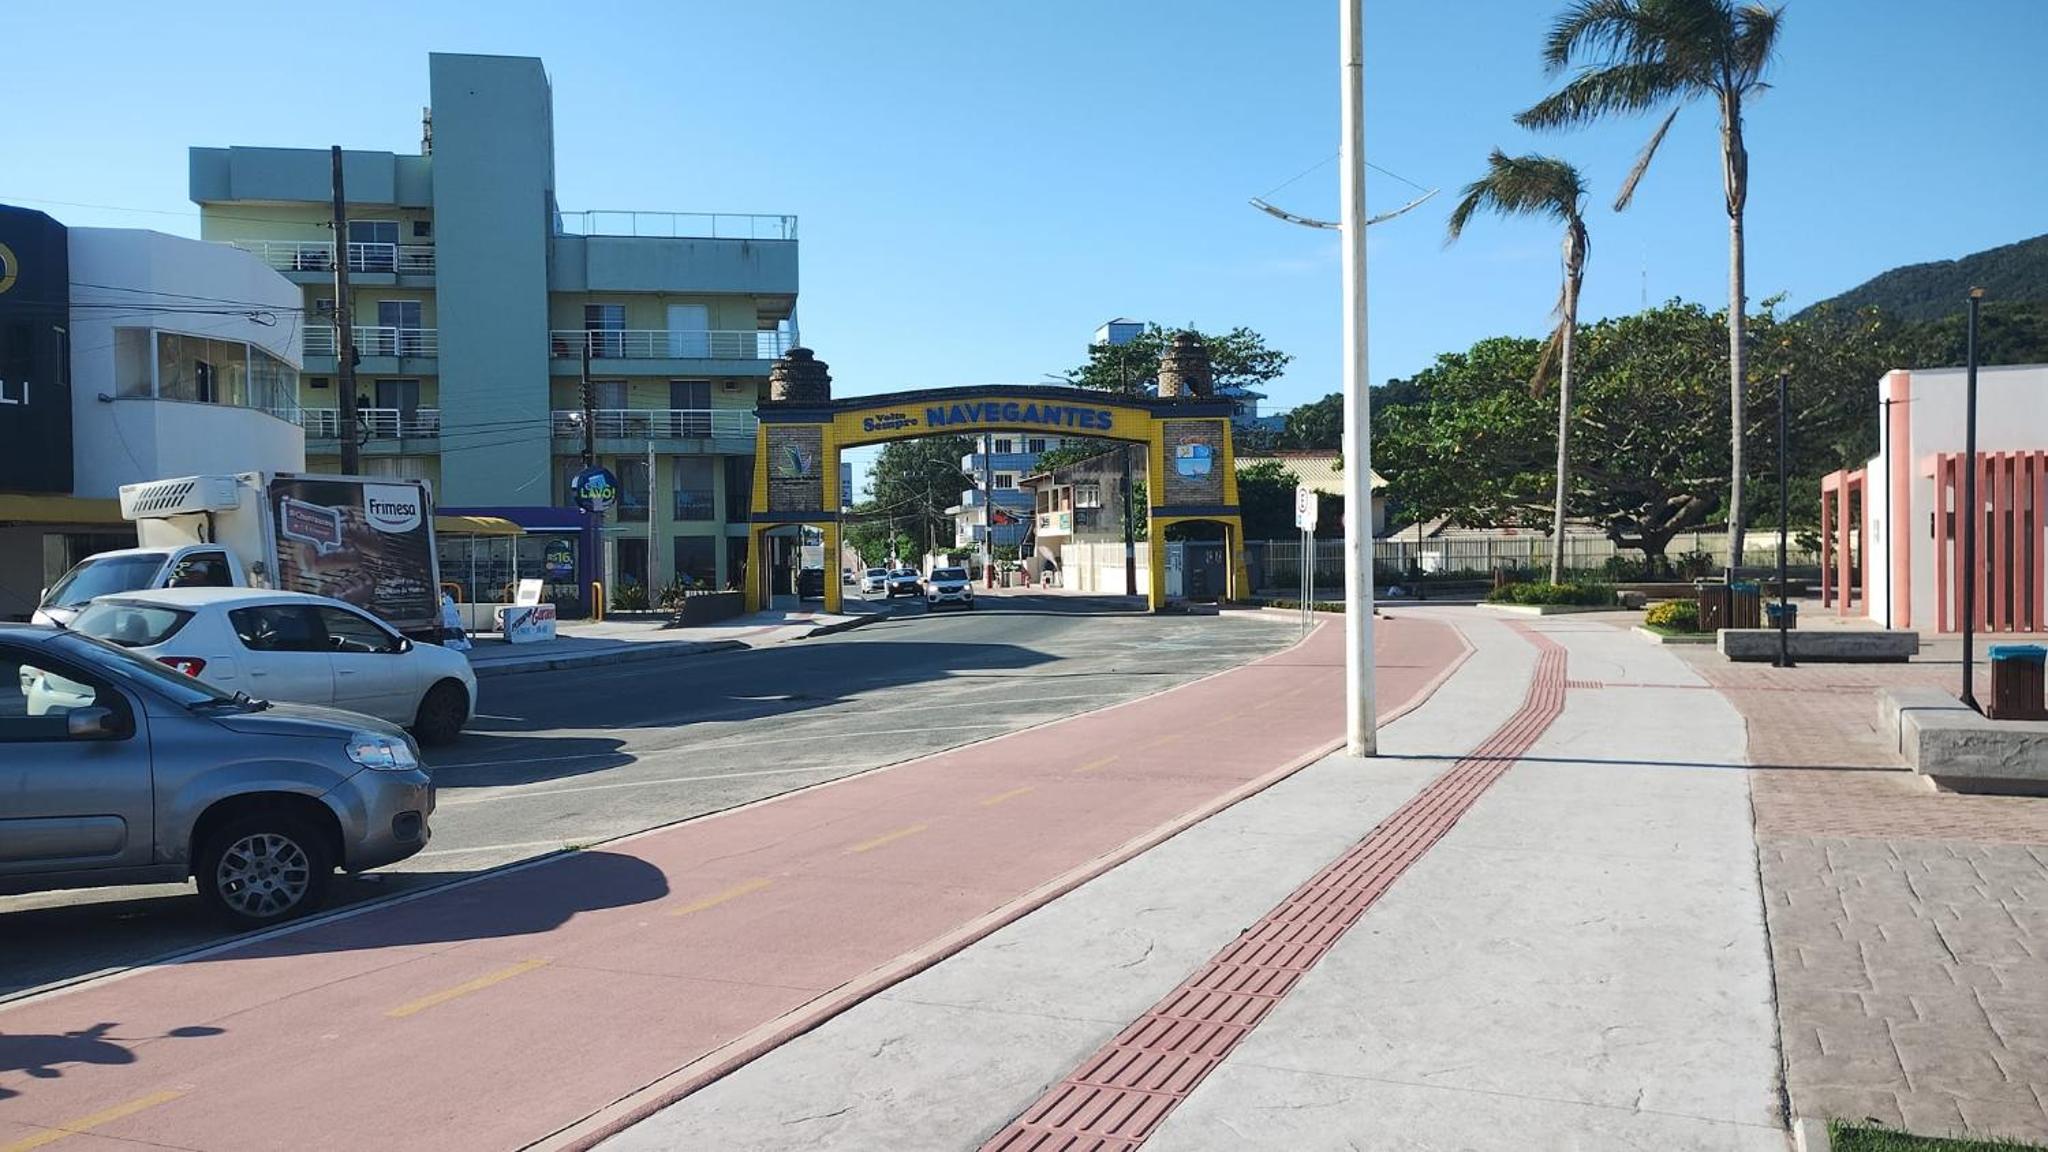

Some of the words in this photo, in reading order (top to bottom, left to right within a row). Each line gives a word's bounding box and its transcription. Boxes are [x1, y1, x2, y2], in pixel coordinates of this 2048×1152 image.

[863, 417, 919, 432] Sempre
[926, 401, 1113, 430] NAVEGANTES
[369, 498, 416, 516] Frimesa
